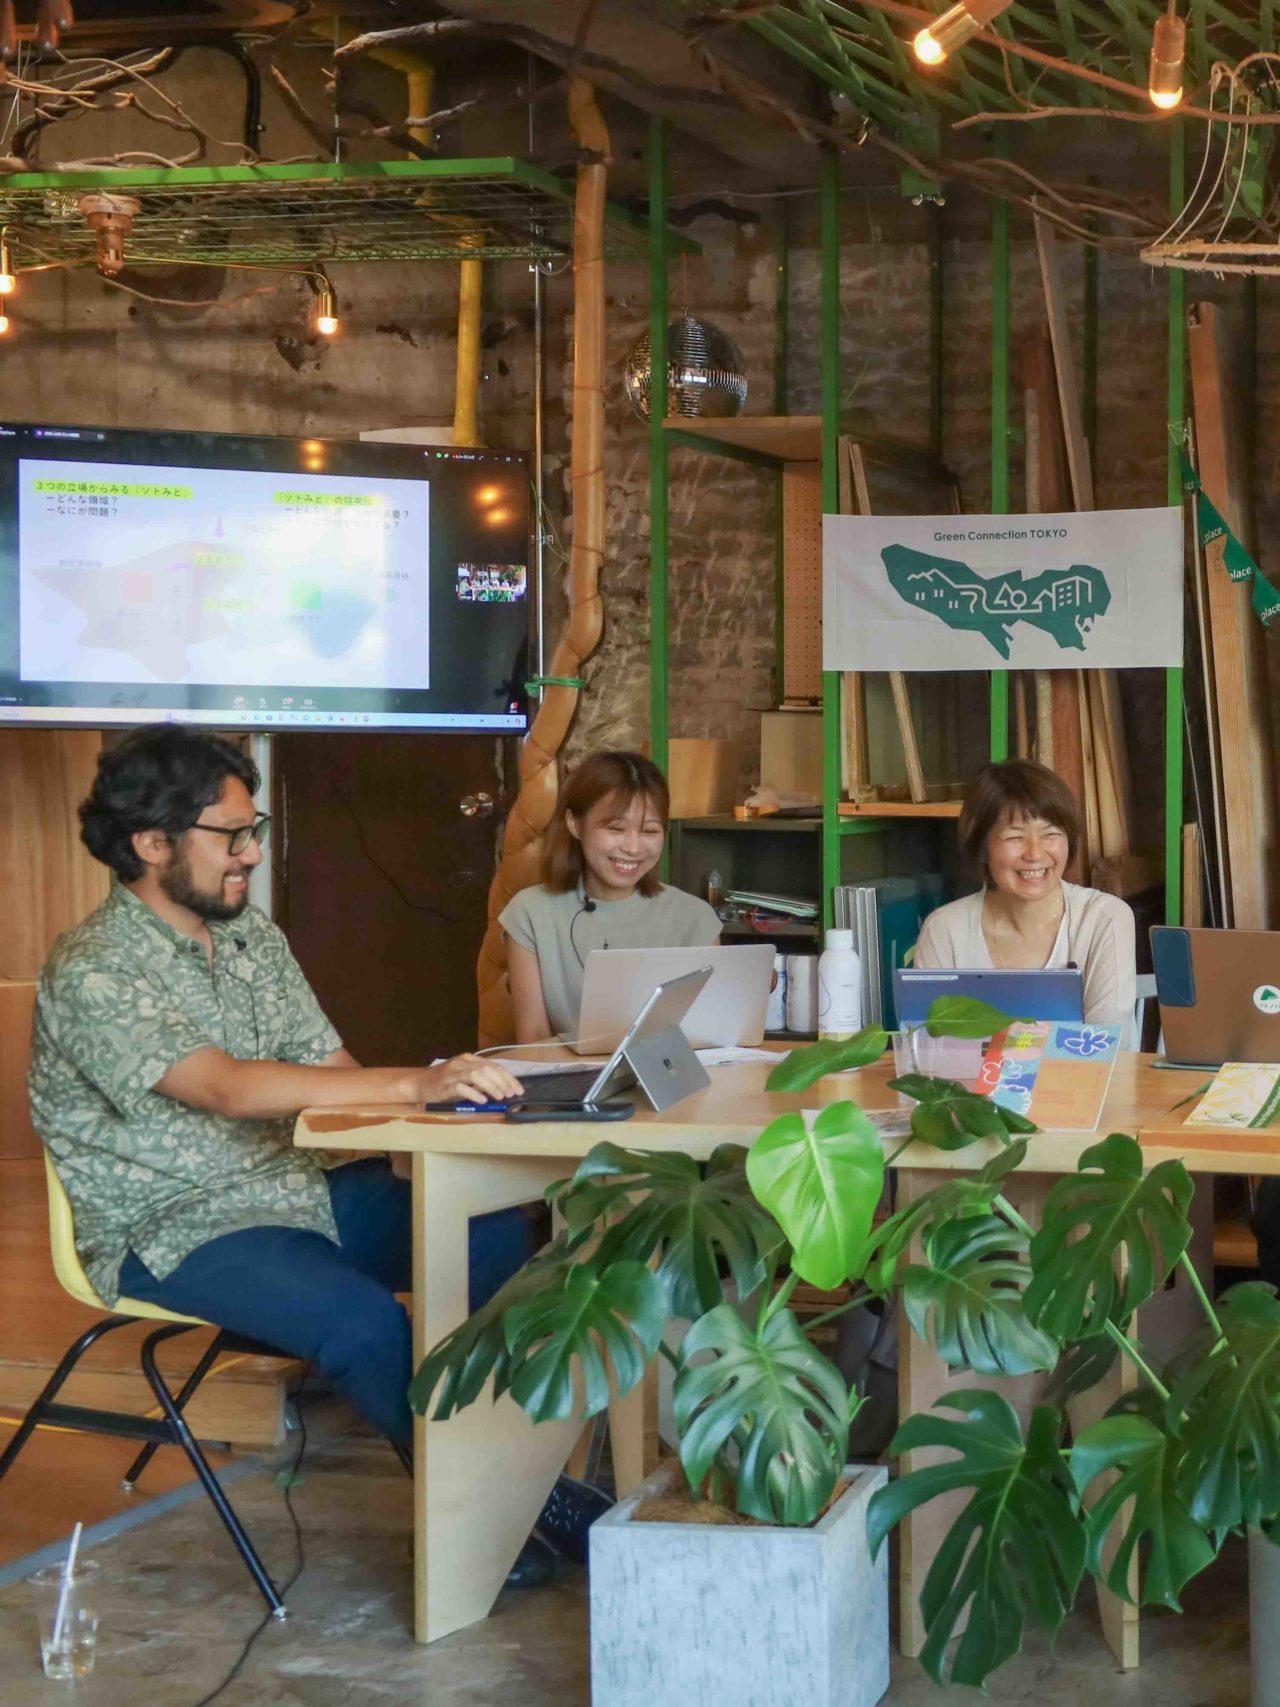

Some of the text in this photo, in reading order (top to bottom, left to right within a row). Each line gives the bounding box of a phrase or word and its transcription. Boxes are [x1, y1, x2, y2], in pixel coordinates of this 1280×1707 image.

[934, 528, 1068, 541] Green Connection TOKYO
